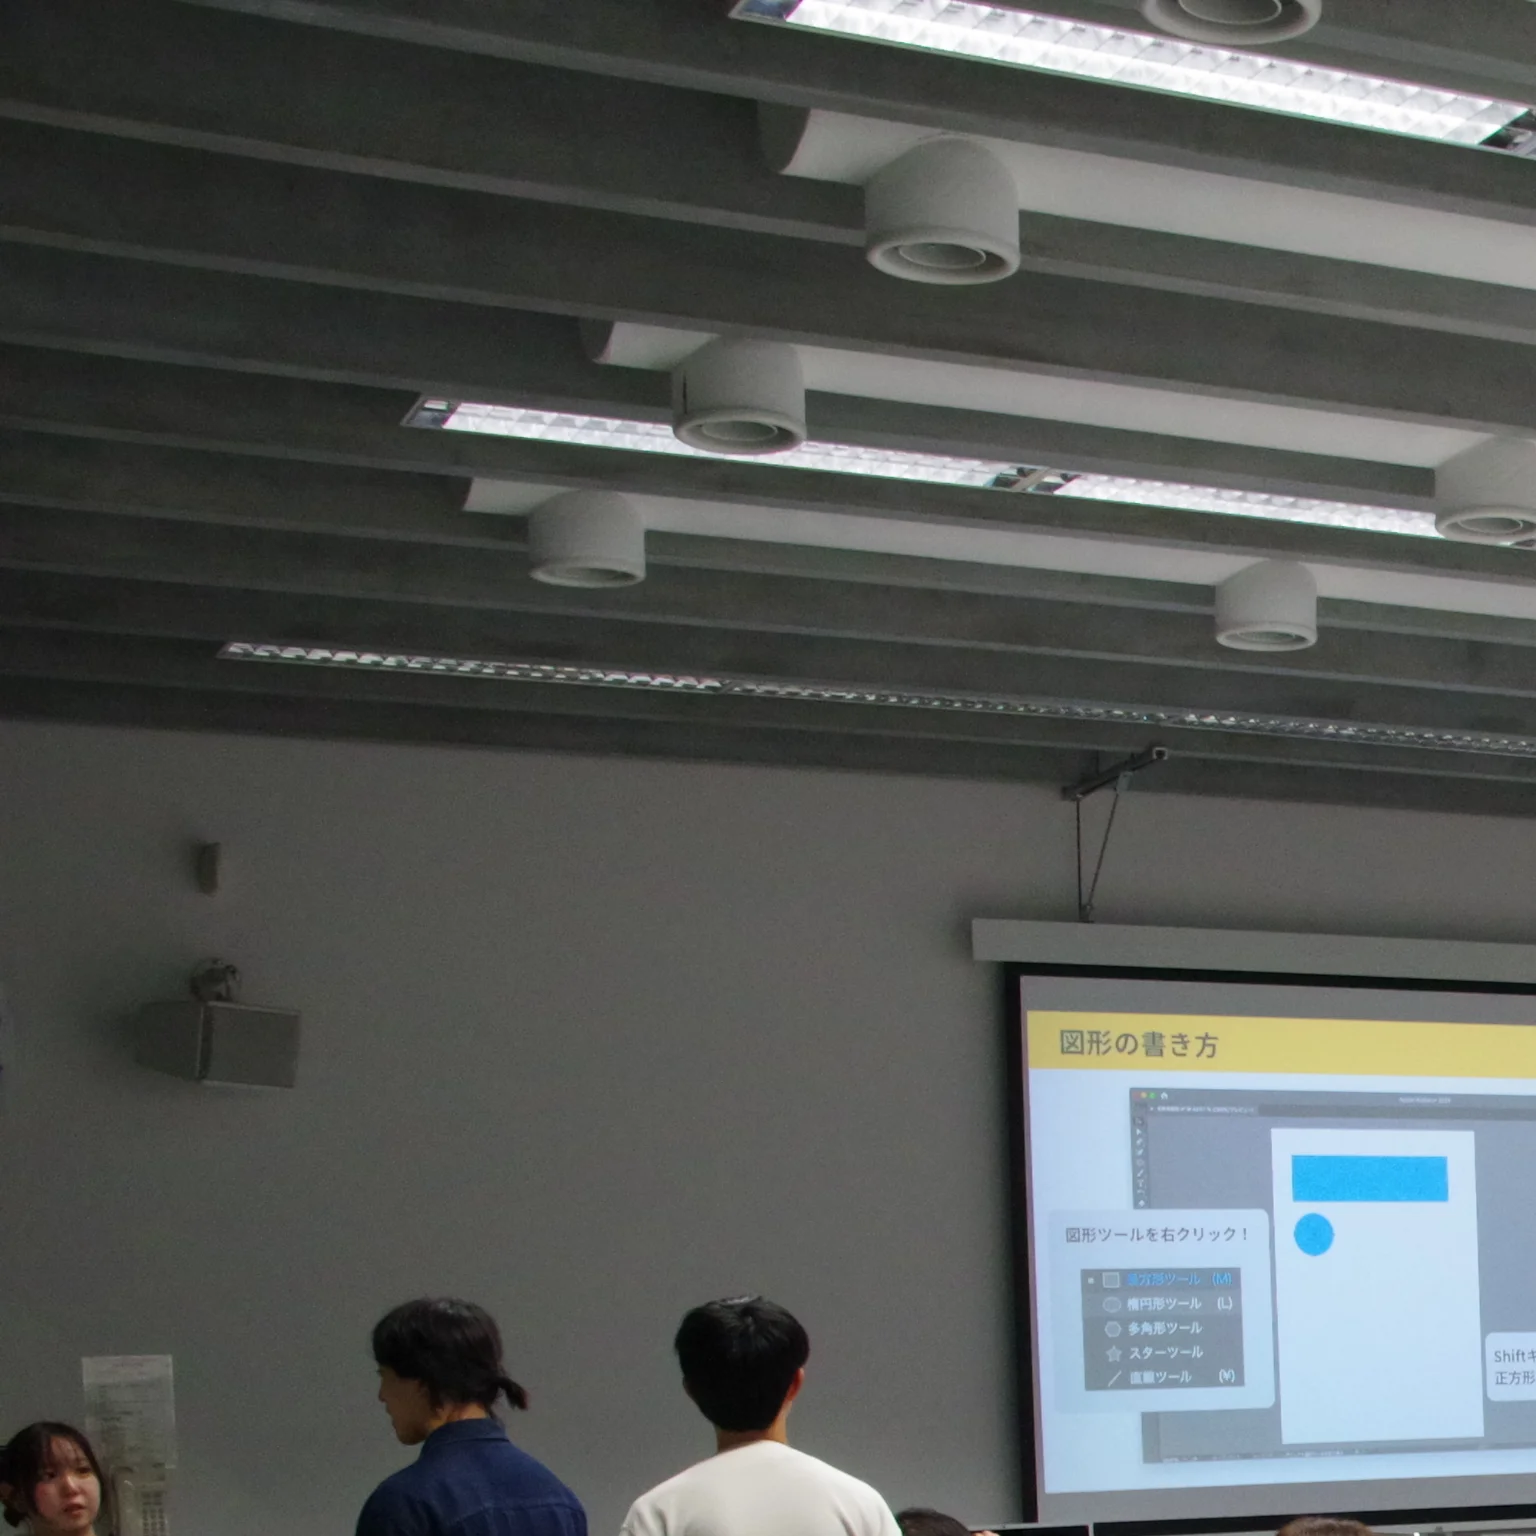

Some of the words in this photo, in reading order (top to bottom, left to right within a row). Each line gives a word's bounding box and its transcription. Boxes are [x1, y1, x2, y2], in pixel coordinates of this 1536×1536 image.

[1059, 1029, 1220, 1059] 図形の書き方
[1128, 1320, 1203, 1336] 多角形ツール
[1129, 1345, 1204, 1360] スターツール
